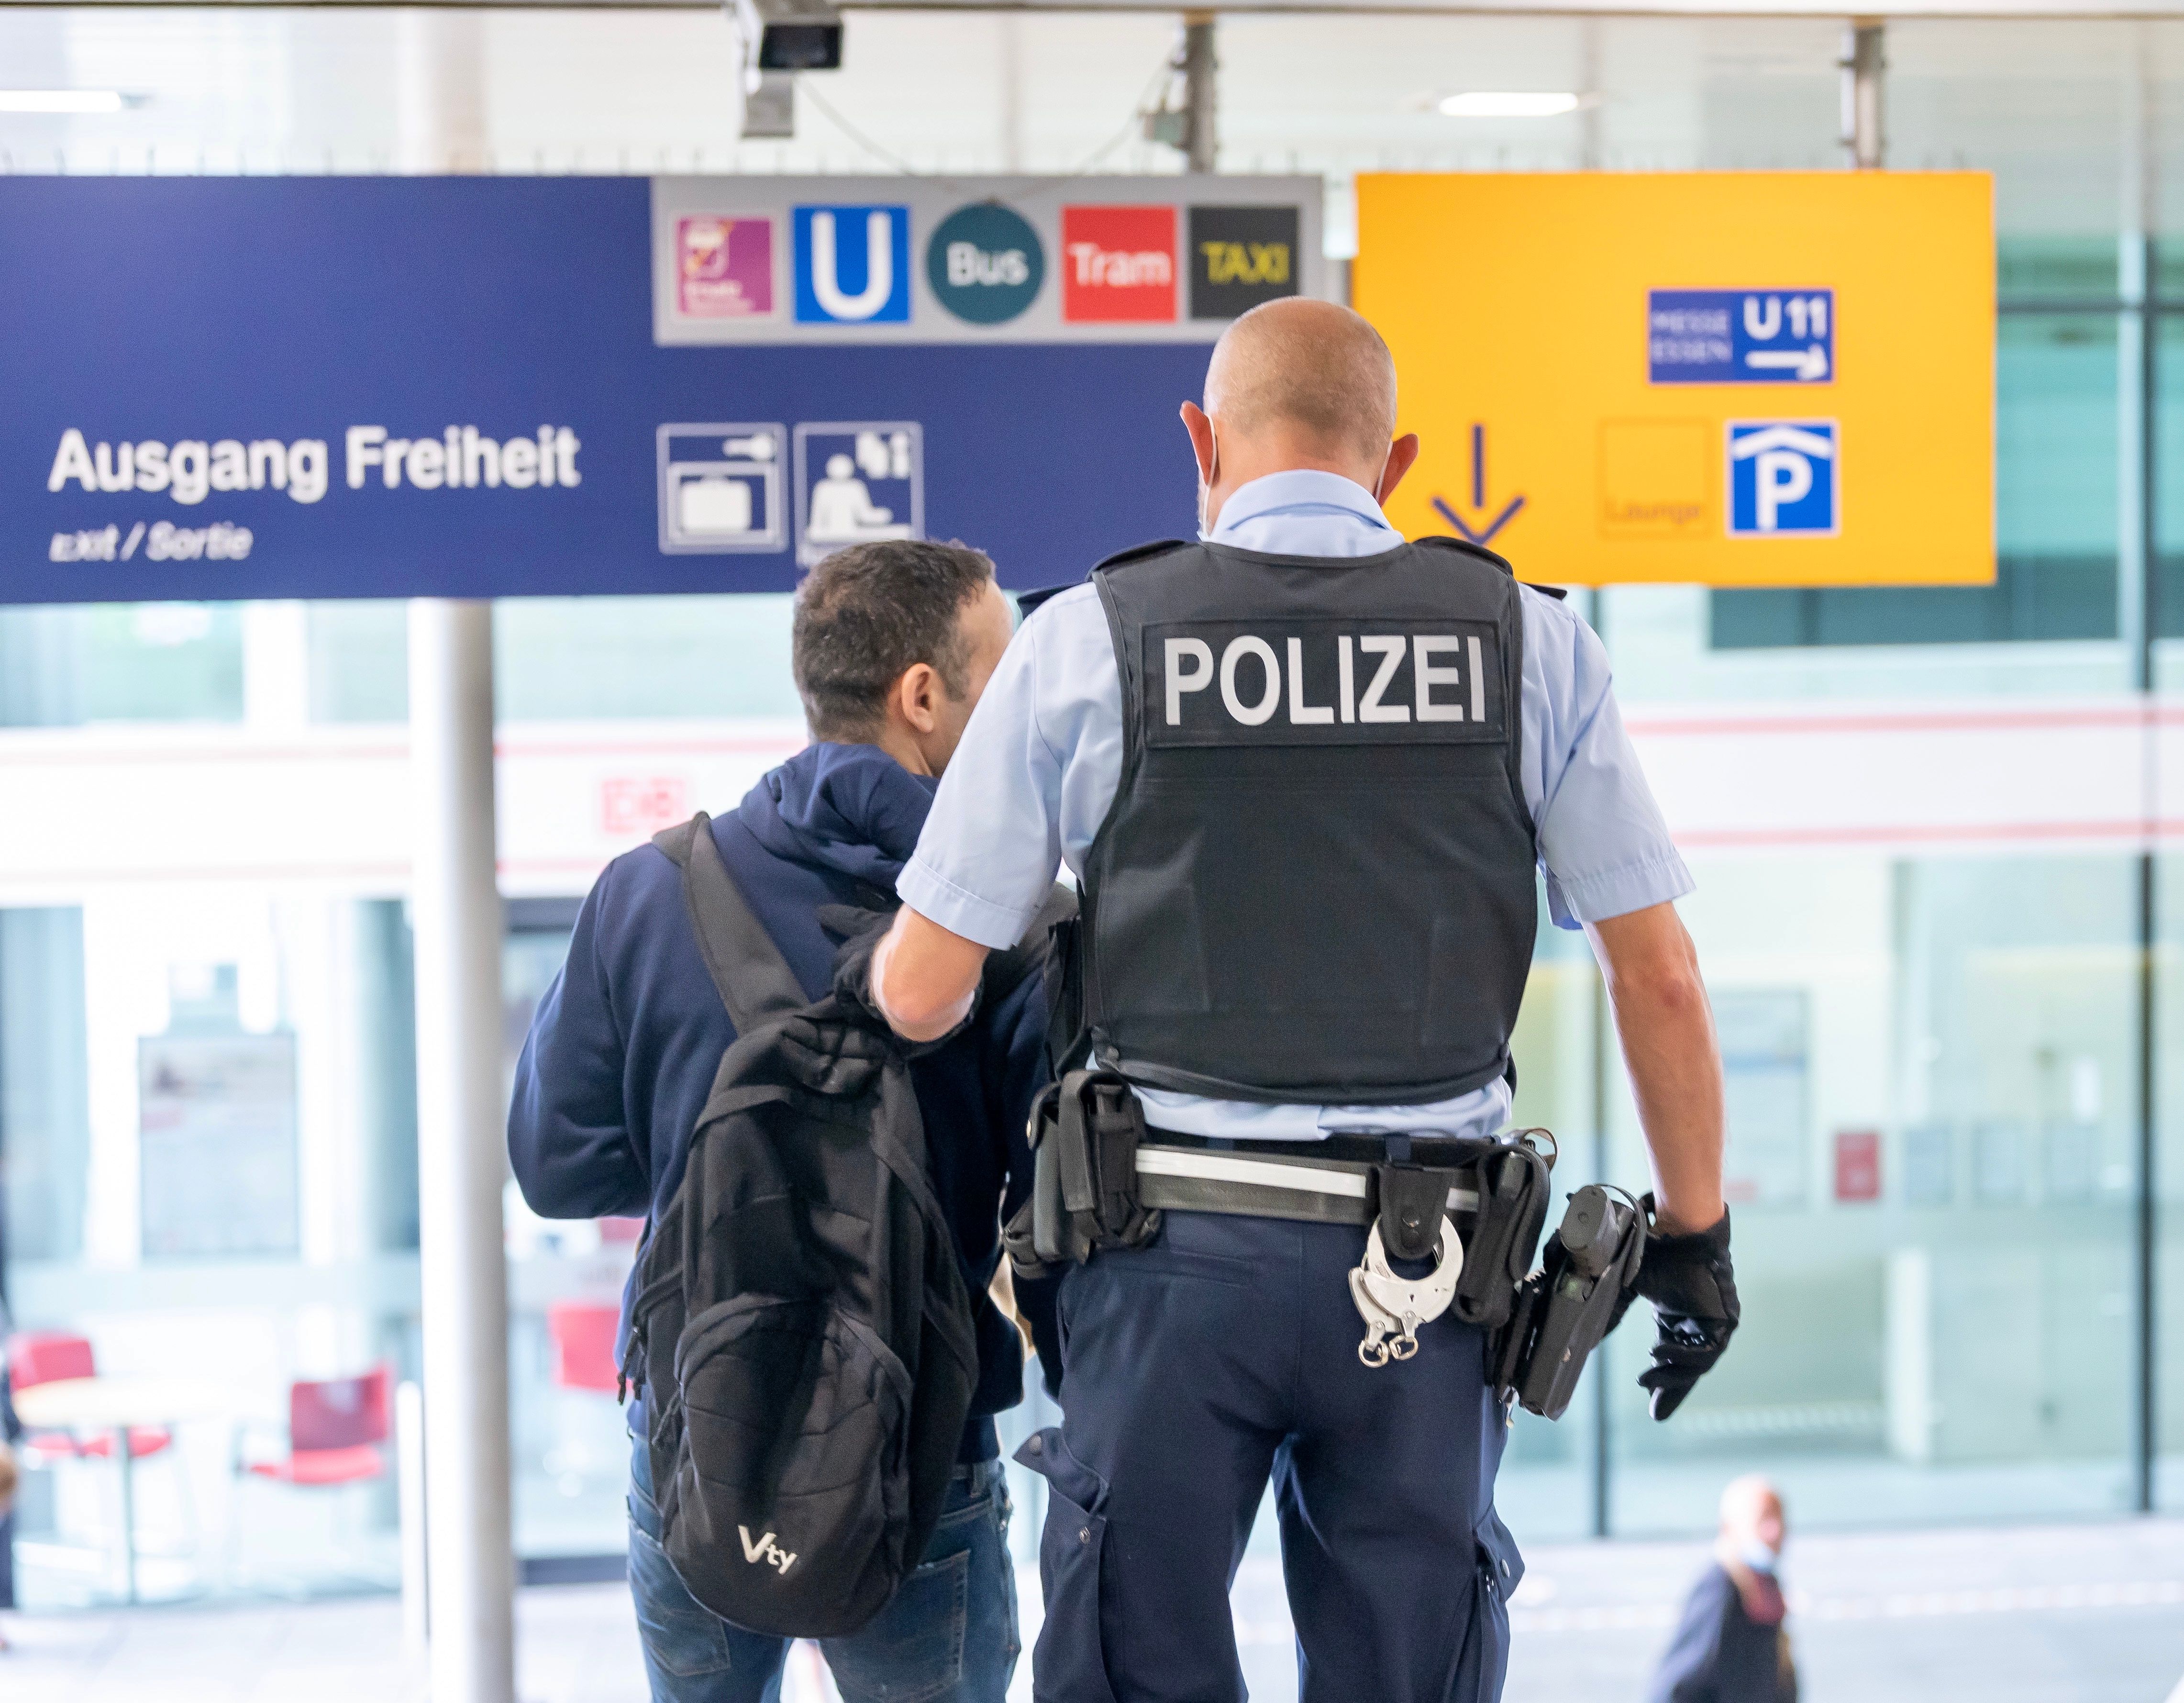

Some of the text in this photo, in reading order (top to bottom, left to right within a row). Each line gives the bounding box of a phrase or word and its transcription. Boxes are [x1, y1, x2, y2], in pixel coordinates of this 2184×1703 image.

[811, 211, 893, 319] U
[946, 241, 1029, 286] Bus
[1068, 243, 1171, 286] Tram
[1202, 242, 1289, 283] TAXI
[48, 424, 581, 505] Ausgang Freiheit
[1755, 450, 1814, 532] P
[146, 521, 254, 561] Sortie
[1164, 634, 1486, 726] POLIZEI
[737, 1524, 799, 1575] Vty
